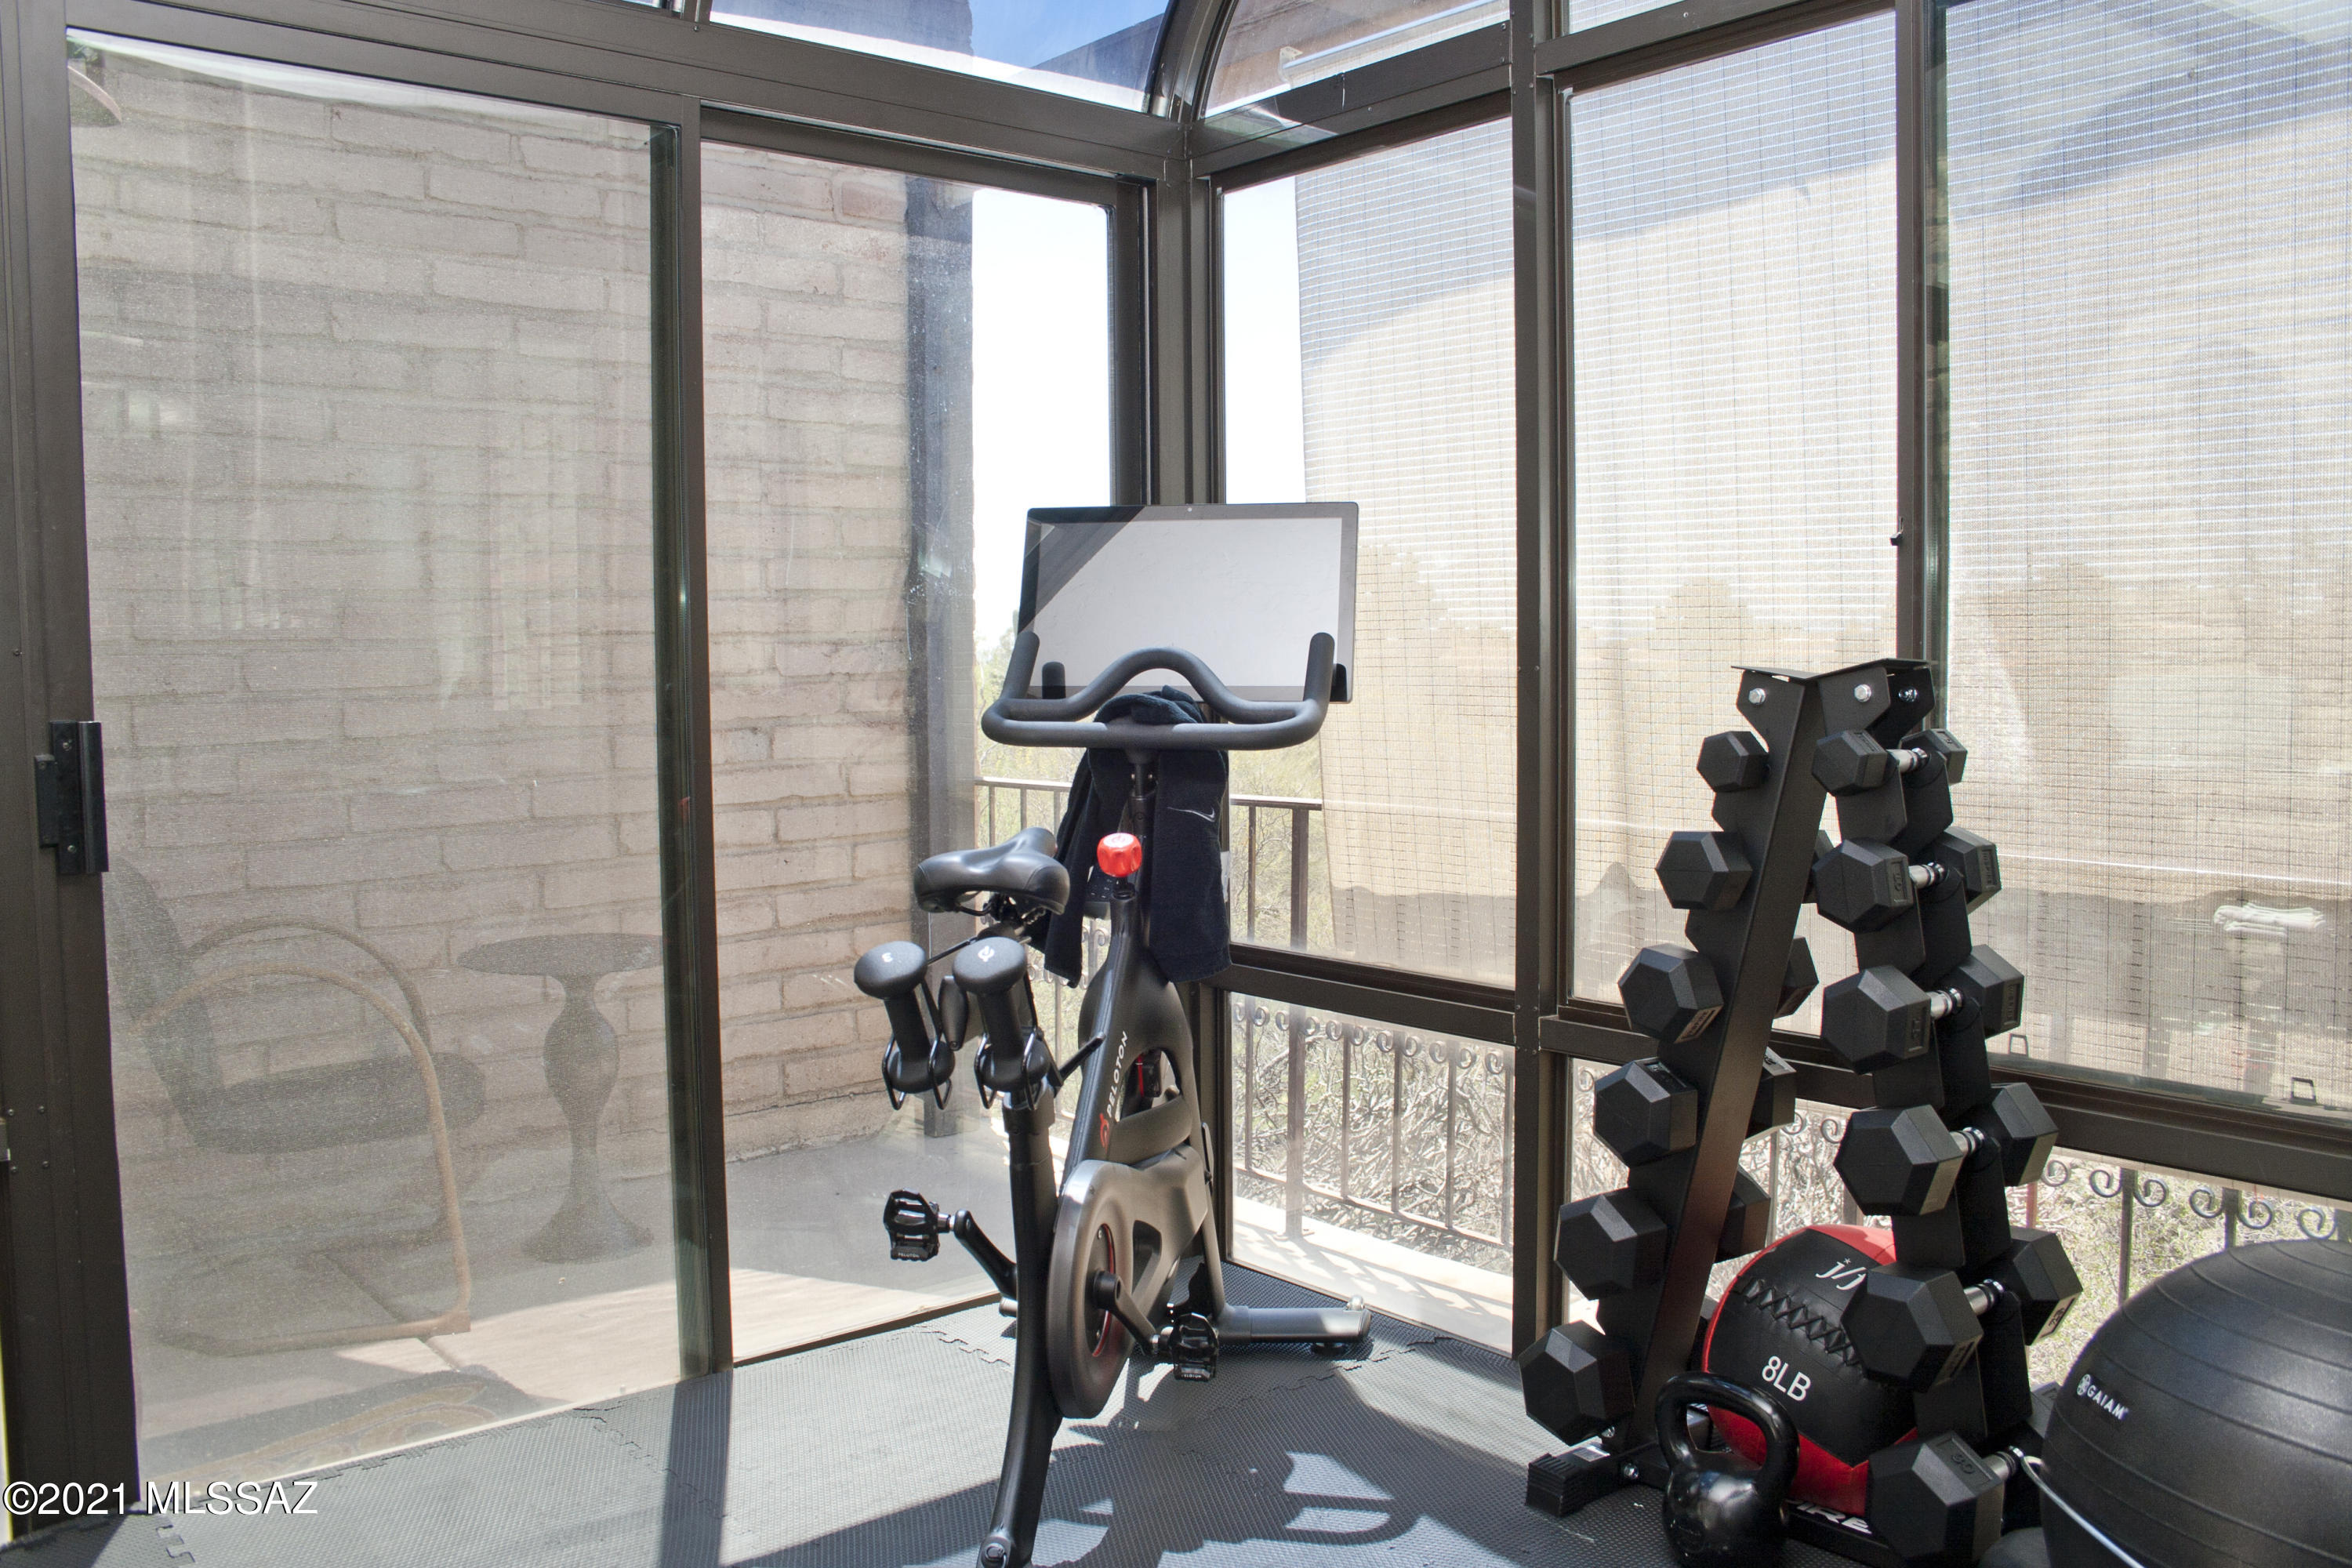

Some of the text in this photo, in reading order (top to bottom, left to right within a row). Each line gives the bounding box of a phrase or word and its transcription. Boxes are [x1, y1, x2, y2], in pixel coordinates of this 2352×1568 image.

[1106, 1031, 1127, 1118] PELOTON
[1762, 1356, 1811, 1401] 8LB
[2087, 1385, 2127, 1420] GAIAM
[1784, 1499, 1872, 1534] IRE
